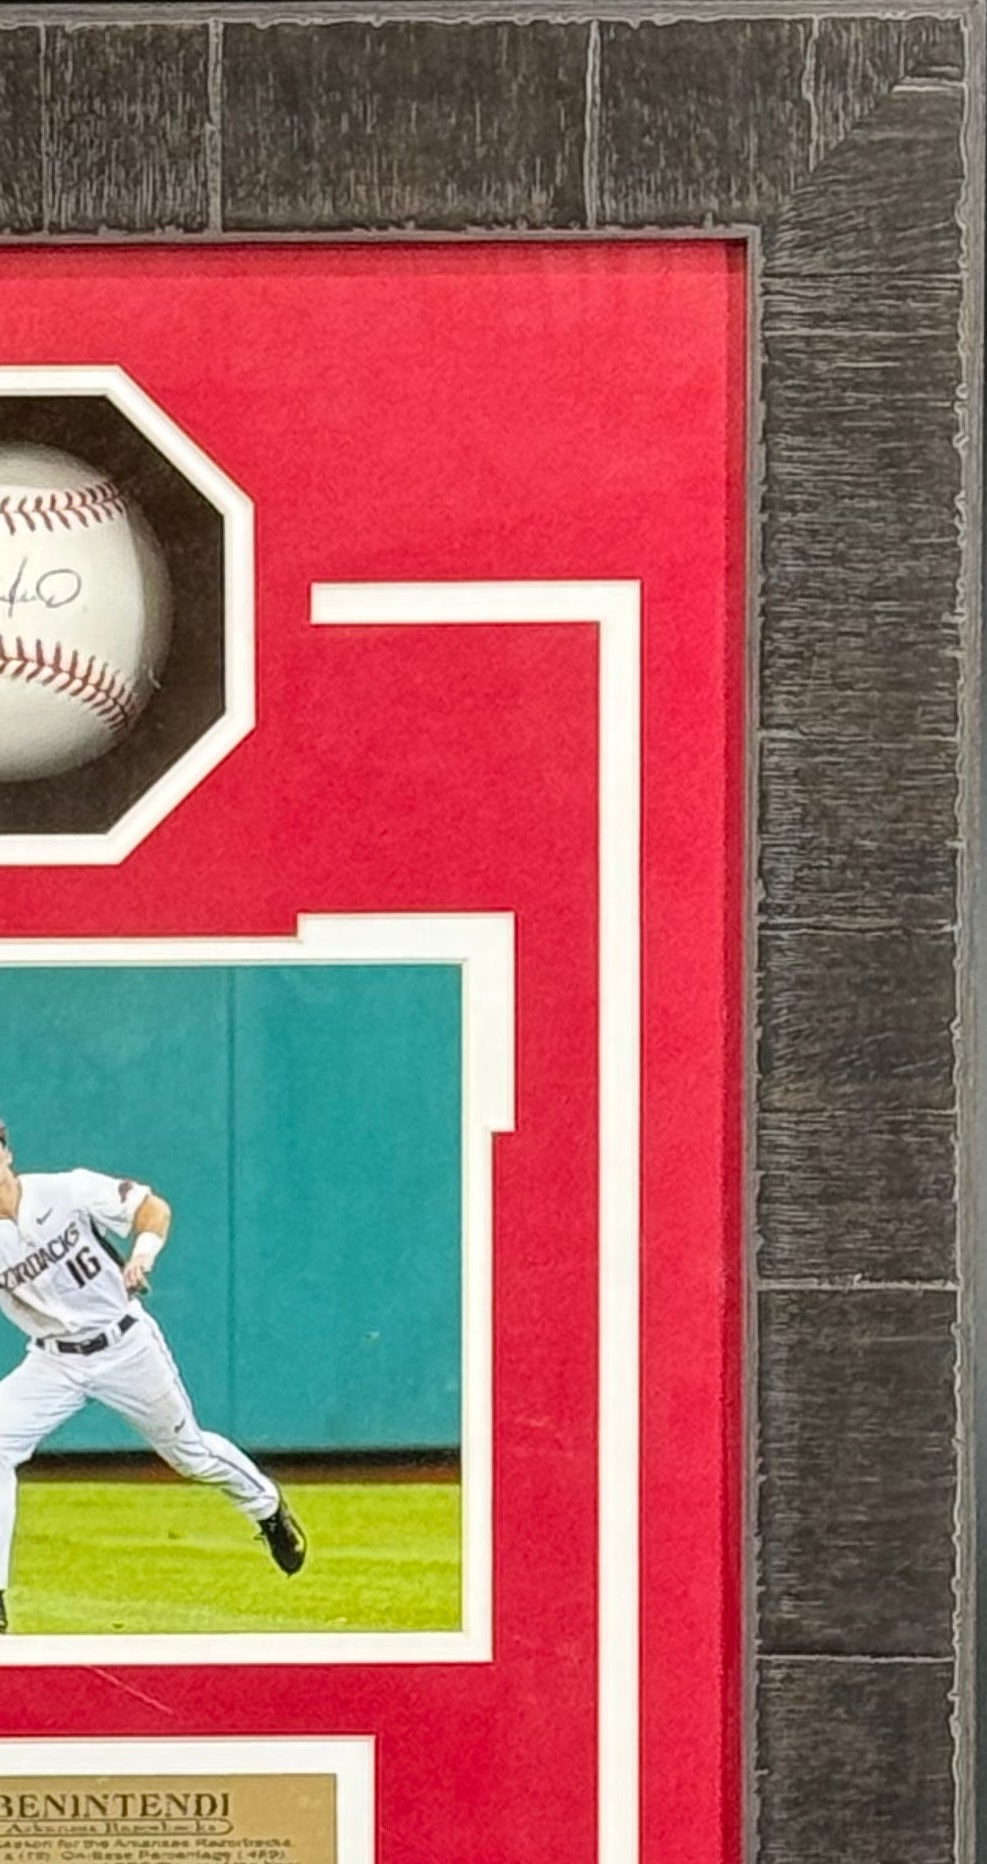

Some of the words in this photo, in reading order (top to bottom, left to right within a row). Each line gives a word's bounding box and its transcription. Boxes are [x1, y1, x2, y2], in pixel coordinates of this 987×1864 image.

[66, 1246, 102, 1289] 16
[58, 1839, 81, 1849] for
[83, 1840, 110, 1849] the
[113, 1839, 189, 1848] Arkansas
